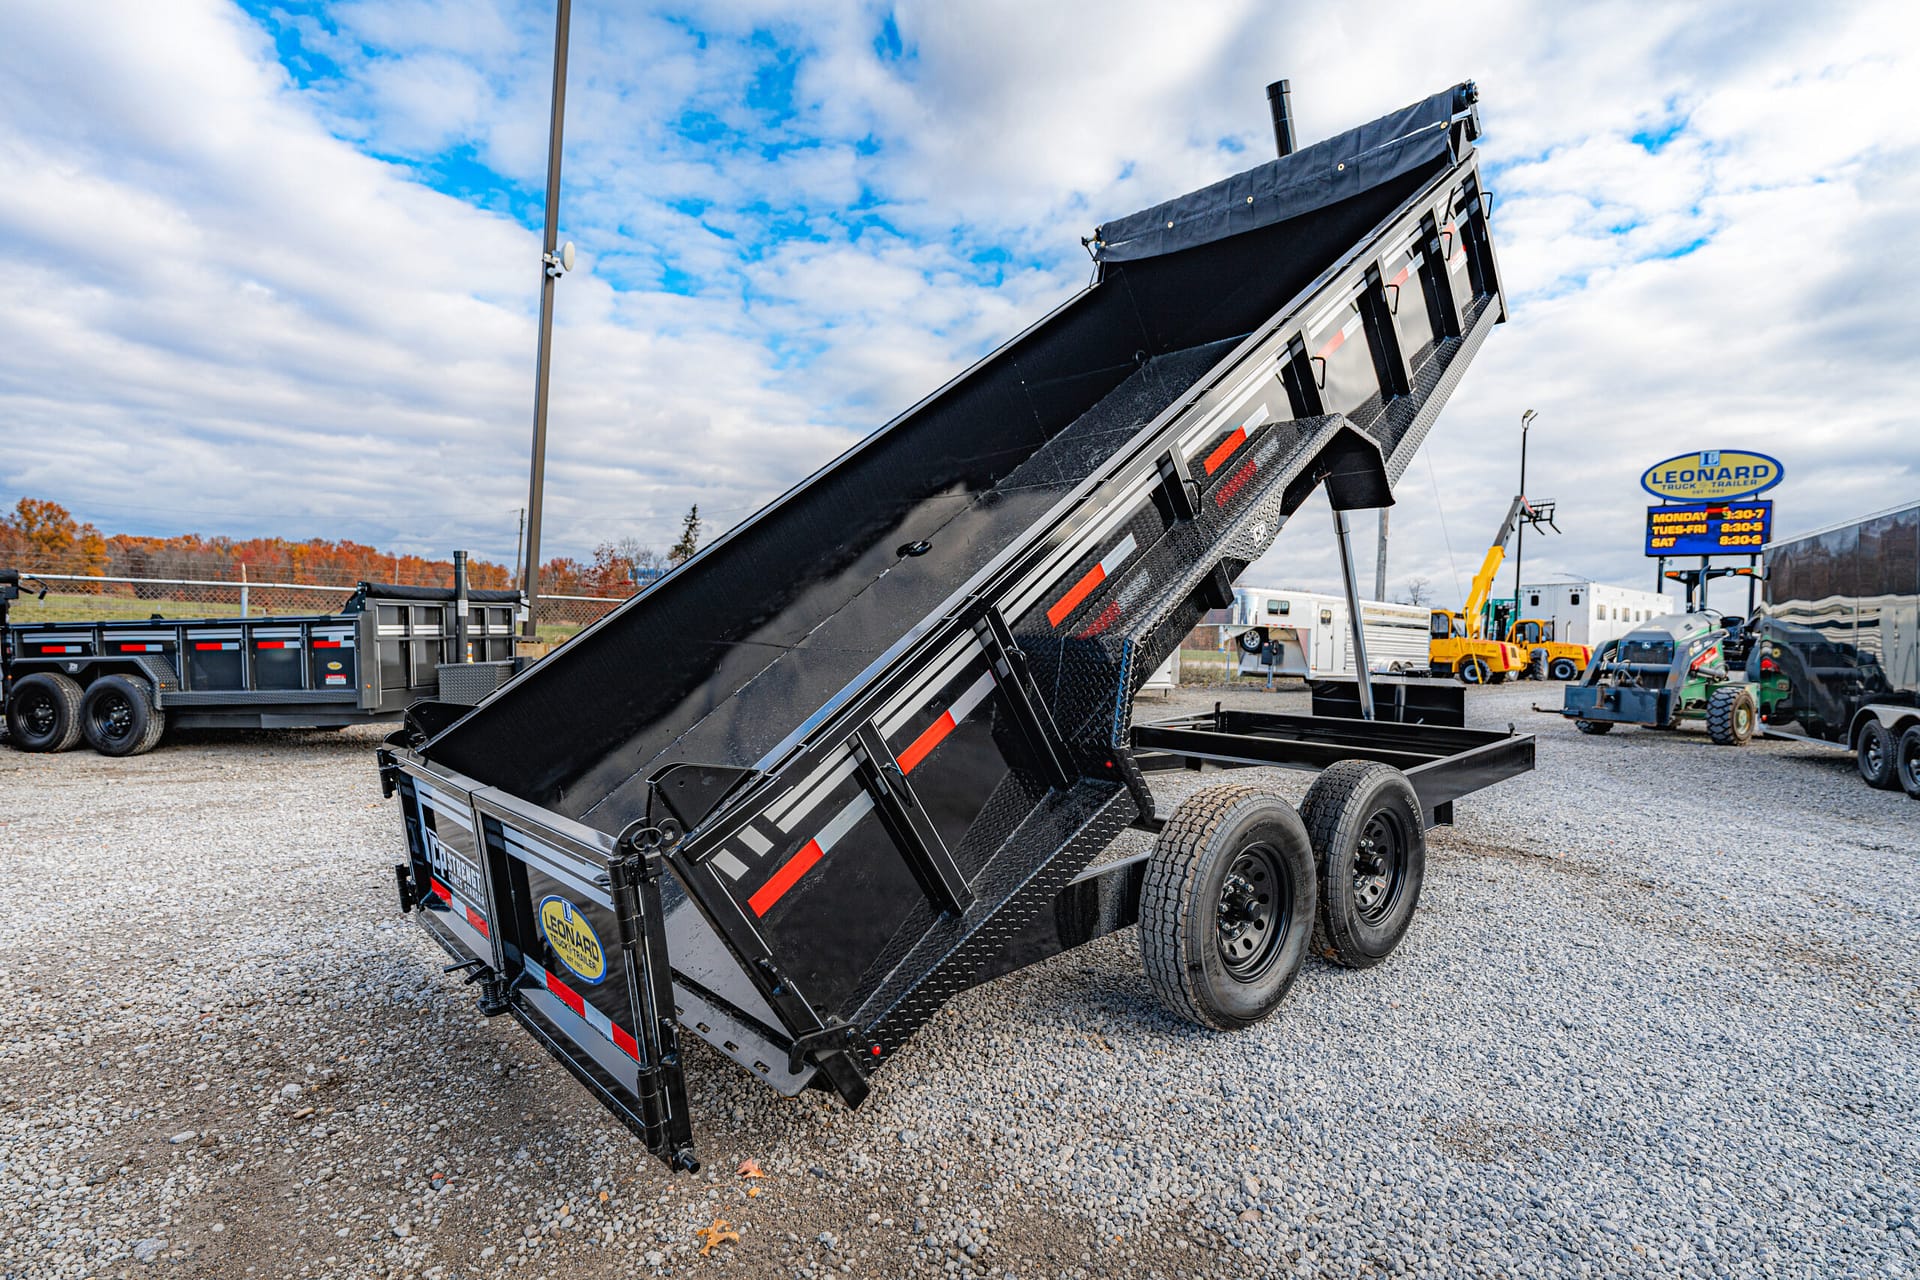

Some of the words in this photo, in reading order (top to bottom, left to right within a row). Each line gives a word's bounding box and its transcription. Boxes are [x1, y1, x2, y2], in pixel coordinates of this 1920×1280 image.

[1652, 465, 1769, 485] LEONARD
[1711, 479, 1758, 488] TRAILER
[1652, 512, 1708, 523] MONDAY
[1652, 524, 1708, 535] TUES-FRI
[1720, 522, 1763, 533] 8:30-5
[1651, 537, 1676, 548] SAT
[1719, 535, 1762, 546] 8:30-2
[447, 851, 481, 893] STRENGT
[544, 911, 600, 963] LEONARD
